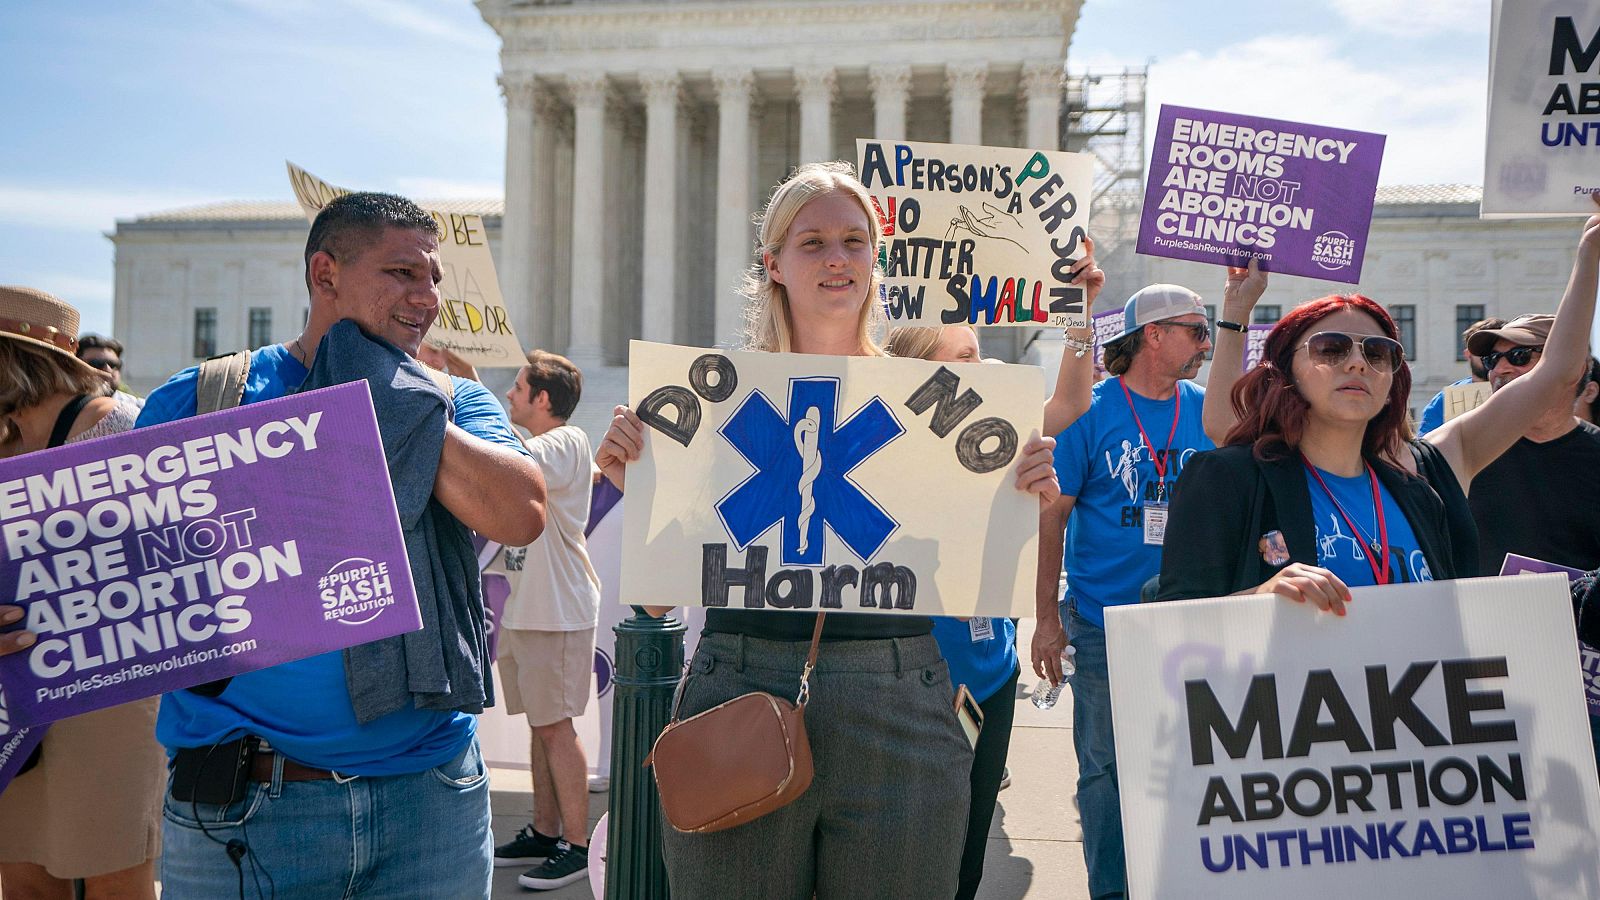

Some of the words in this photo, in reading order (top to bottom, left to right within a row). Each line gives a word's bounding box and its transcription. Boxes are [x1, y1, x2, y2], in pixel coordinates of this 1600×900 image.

[1168, 142, 1286, 178] ROOMS
[1172, 118, 1358, 164] EMERGENCY
[861, 143, 894, 189] A
[1162, 166, 1228, 194] ARE
[1232, 174, 1301, 206] NOT
[451, 212, 483, 246] BE
[1156, 212, 1277, 249] CLINICS
[1158, 190, 1315, 231] ABORTION
[1154, 236, 1273, 262] PurpleSashRevolution.com
[1311, 255, 1352, 266] REVOLUTION
[1313, 243, 1354, 260] SASH
[1315, 236, 1355, 248] #PURPLE
[485, 304, 512, 336] OR
[941, 273, 1048, 325] SMALL
[636, 353, 738, 448] DO
[904, 365, 1019, 474] NO
[0, 411, 323, 521] EMERGENCY
[3, 480, 217, 560] ROOMS
[15, 541, 128, 601] ARE
[137, 508, 257, 572] NOT
[318, 562, 388, 590] #PURPLE
[702, 542, 917, 610] Harm
[25, 539, 303, 637] ABORTION
[321, 574, 393, 609] SASH
[324, 595, 395, 621] REVOLUTION
[29, 595, 252, 679] CLINICS
[36, 638, 258, 703] PurpleSashRevolution.com
[1184, 655, 1518, 766] MAKE
[1197, 753, 1527, 825] ABORTION
[1200, 812, 1535, 873] UNTHINKABLE
